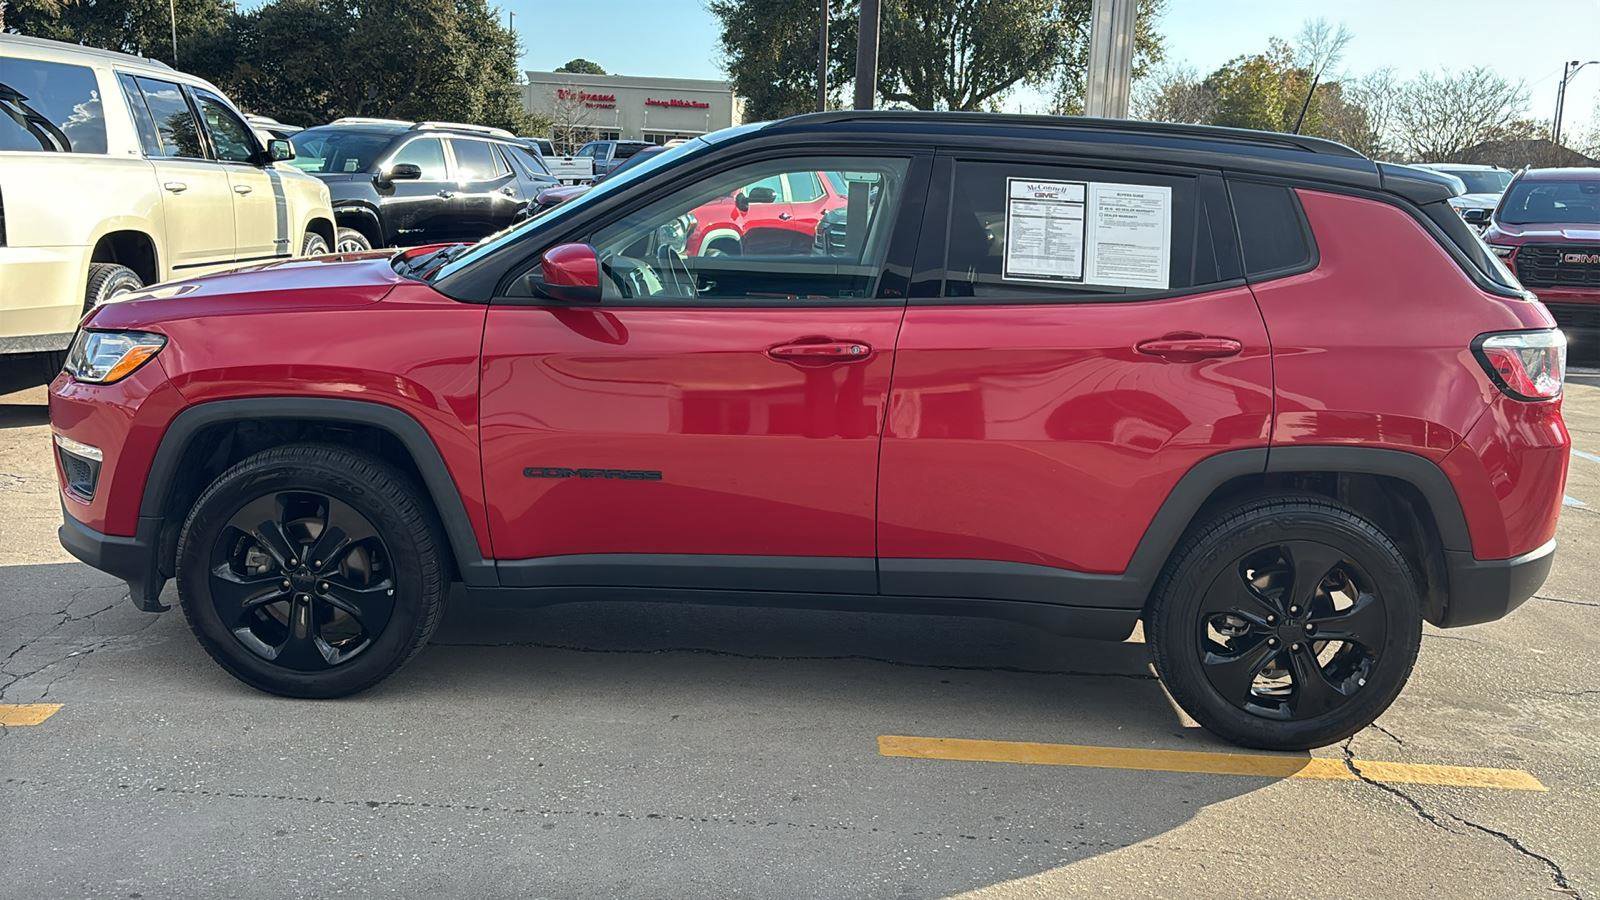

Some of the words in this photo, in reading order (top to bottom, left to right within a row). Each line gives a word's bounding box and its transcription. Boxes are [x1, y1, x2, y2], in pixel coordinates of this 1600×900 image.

[1027, 184, 1067, 194] McConnell
[1565, 254, 1600, 263] GM
[523, 466, 663, 481] COMPASS
